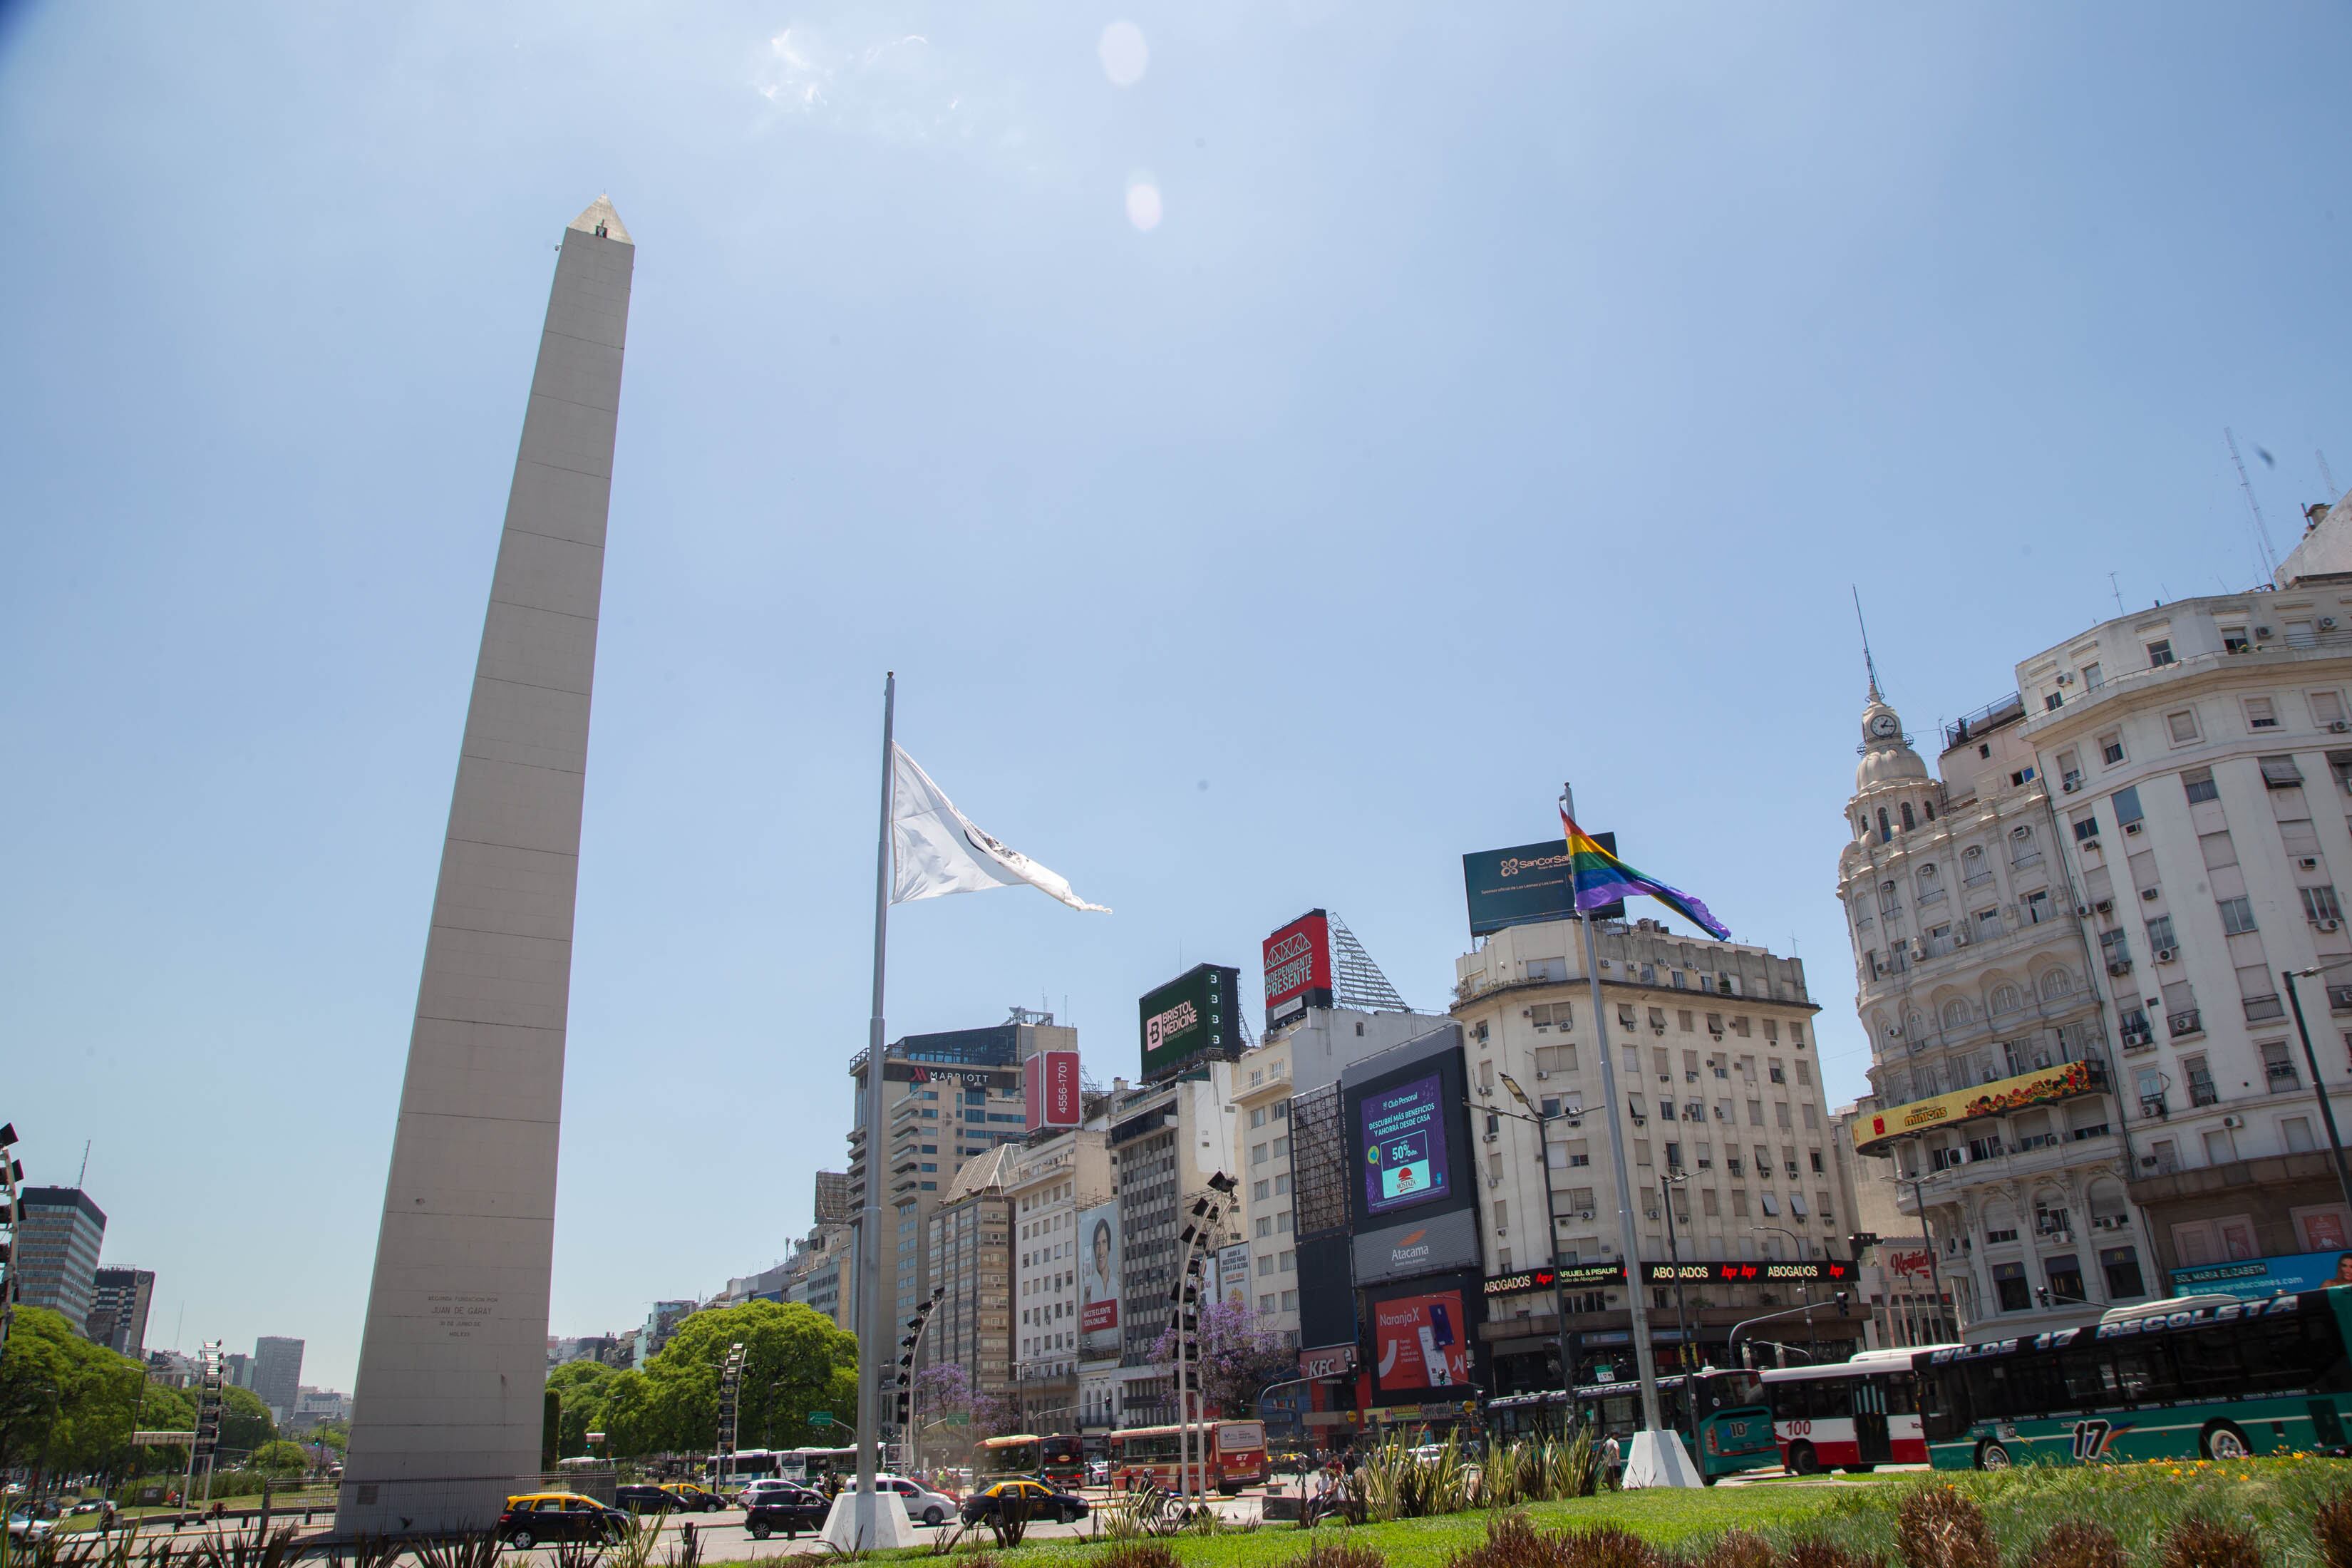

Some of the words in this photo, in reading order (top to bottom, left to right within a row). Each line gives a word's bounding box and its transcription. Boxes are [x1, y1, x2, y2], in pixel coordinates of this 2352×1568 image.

[1519, 854, 1569, 869] SanCorSal
[1266, 964, 1312, 1001] PRESENTE
[1162, 1000, 1194, 1024] BRISTOL
[1163, 1009, 1197, 1037] MEDICINE
[1058, 1061, 1068, 1113] 4556-1701
[1388, 1100, 1399, 1108] Club
[1398, 1092, 1418, 1105] Personal
[1369, 1115, 1393, 1130] DESCUBRÍ
[1393, 1112, 1405, 1123] MÁS
[1405, 1103, 1435, 1118] BENEFICIOS
[1378, 1122, 1399, 1136] AHORRÁ
[1400, 1118, 1416, 1129] DESDE
[1416, 1113, 1430, 1123] CASA
[1392, 1144, 1410, 1160] 50%
[1396, 1180, 1416, 1189] MOSTAZA
[1391, 1245, 1429, 1261] Atacama
[1591, 1267, 1617, 1275] PISAURI
[1768, 1265, 1818, 1277] ABOGADOS
[2175, 1274, 2190, 1283] SOL
[2193, 1271, 2219, 1281] MARIA
[2220, 1264, 2266, 1278] ELIZABETH
[1484, 1275, 1531, 1294] ABOGADOS
[468, 1306, 492, 1315] GARAY
[1095, 1306, 1111, 1316] CLIENTE
[1379, 1311, 1412, 1327] Naranja
[1412, 1306, 1420, 1321] X
[1930, 1337, 2018, 1365] WILDE
[2034, 1327, 2080, 1351] 17
[2096, 1295, 2299, 1341] RECOLETA
[1309, 1358, 1335, 1376] KFC
[1488, 1396, 1540, 1409] WILDE
[1577, 1378, 1684, 1398] RECOLTA
[1786, 1420, 1811, 1436] 100
[2073, 1418, 2112, 1460] 17
